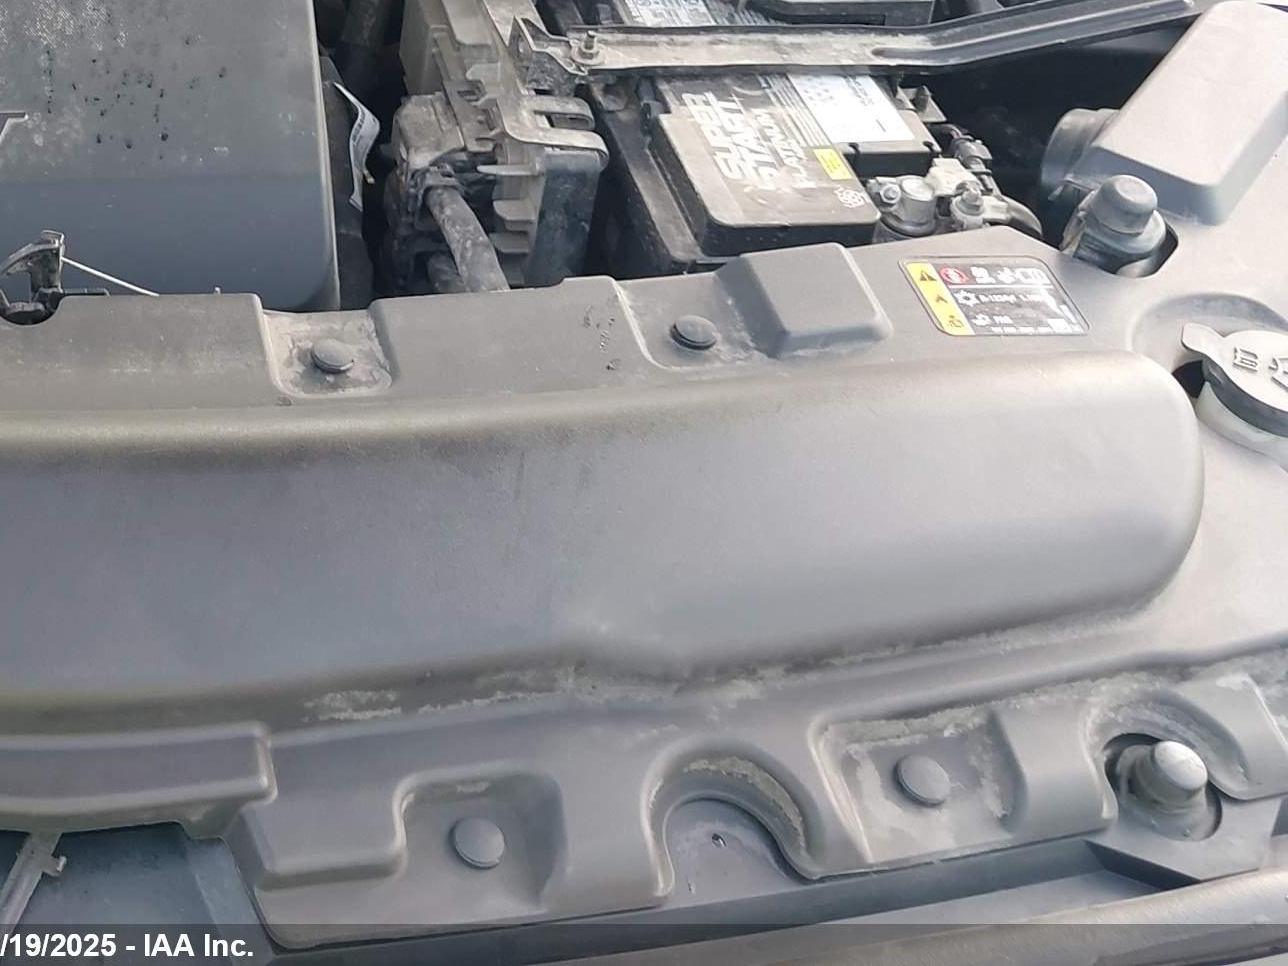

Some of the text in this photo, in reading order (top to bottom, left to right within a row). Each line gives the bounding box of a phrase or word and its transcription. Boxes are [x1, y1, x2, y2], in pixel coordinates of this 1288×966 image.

[681, 92, 745, 179] SUPER
[705, 92, 777, 190] START
[751, 108, 815, 188] PLATINUM
